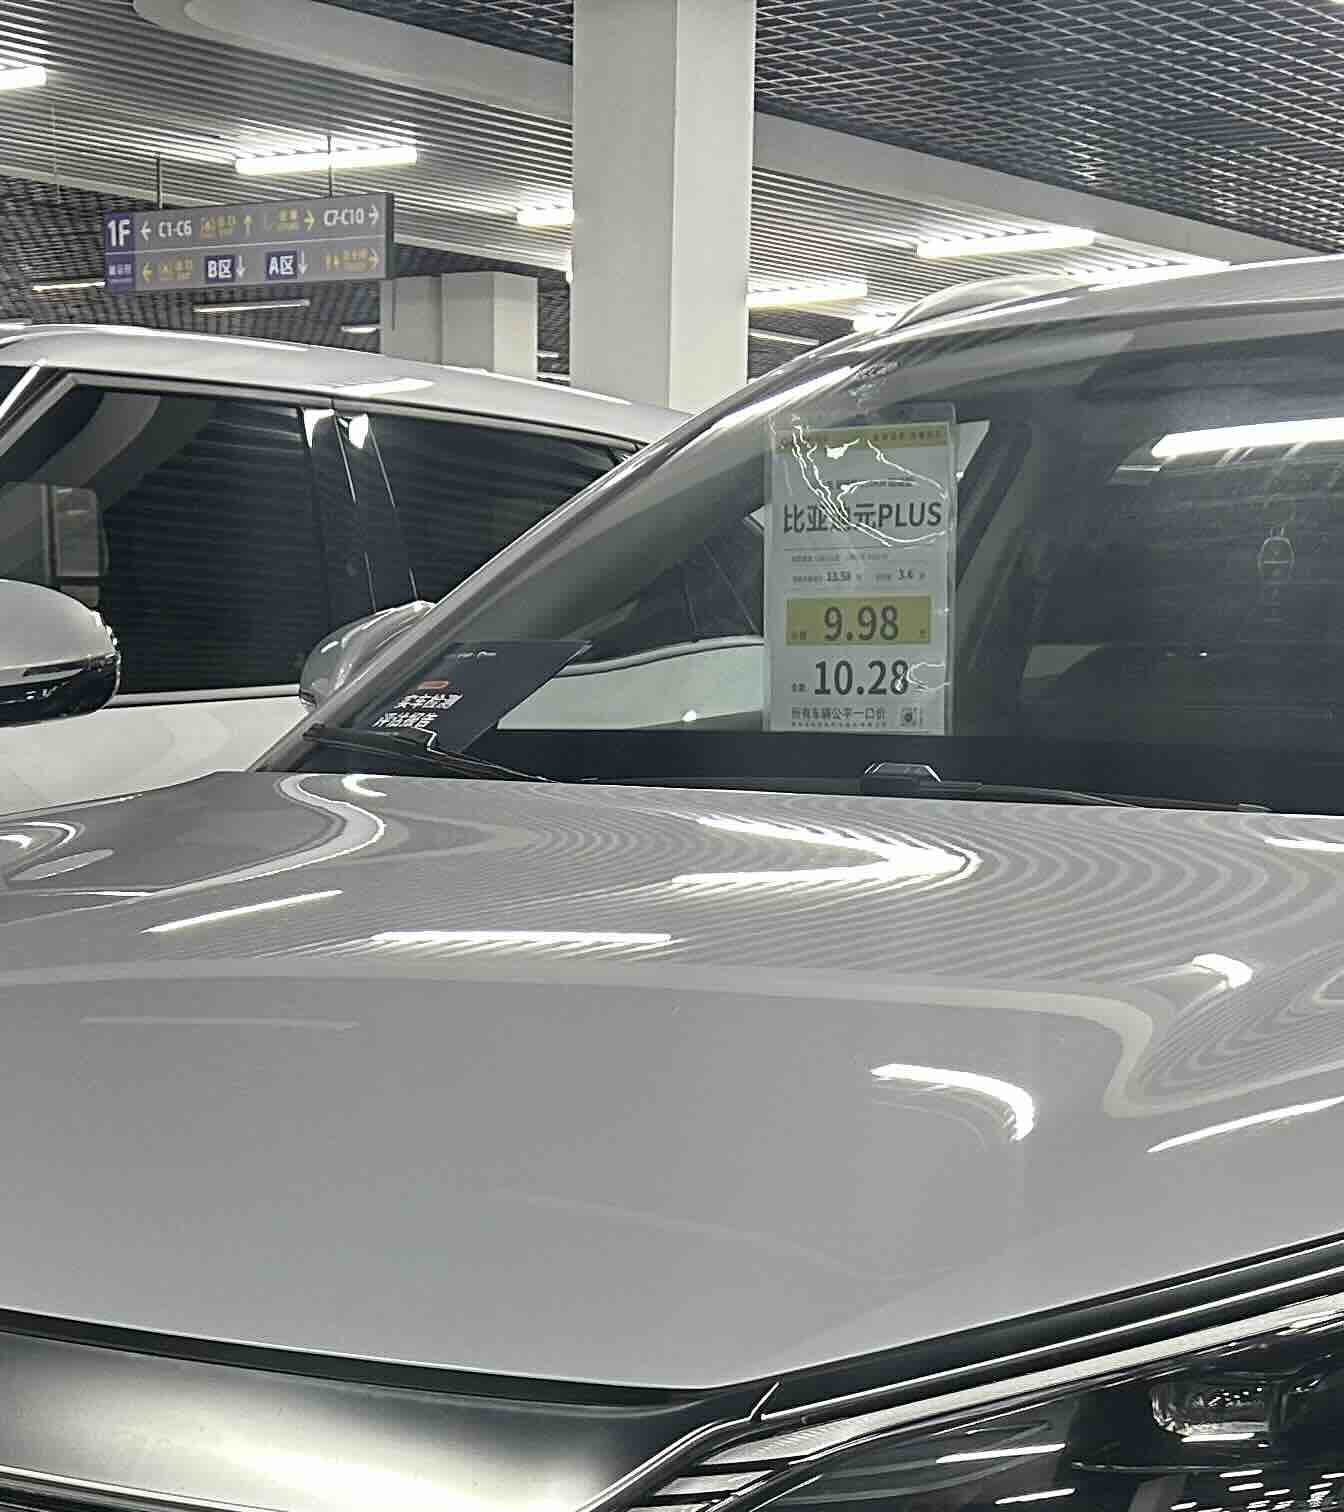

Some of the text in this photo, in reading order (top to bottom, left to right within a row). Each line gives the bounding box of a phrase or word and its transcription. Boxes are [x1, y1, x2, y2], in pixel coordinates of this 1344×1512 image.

[323, 207, 364, 226] C7-C10
[108, 219, 131, 247] 1F
[207, 259, 233, 279] B区
[268, 255, 295, 276] A区
[823, 605, 899, 641] 9.98
[814, 659, 910, 695] 10.28
